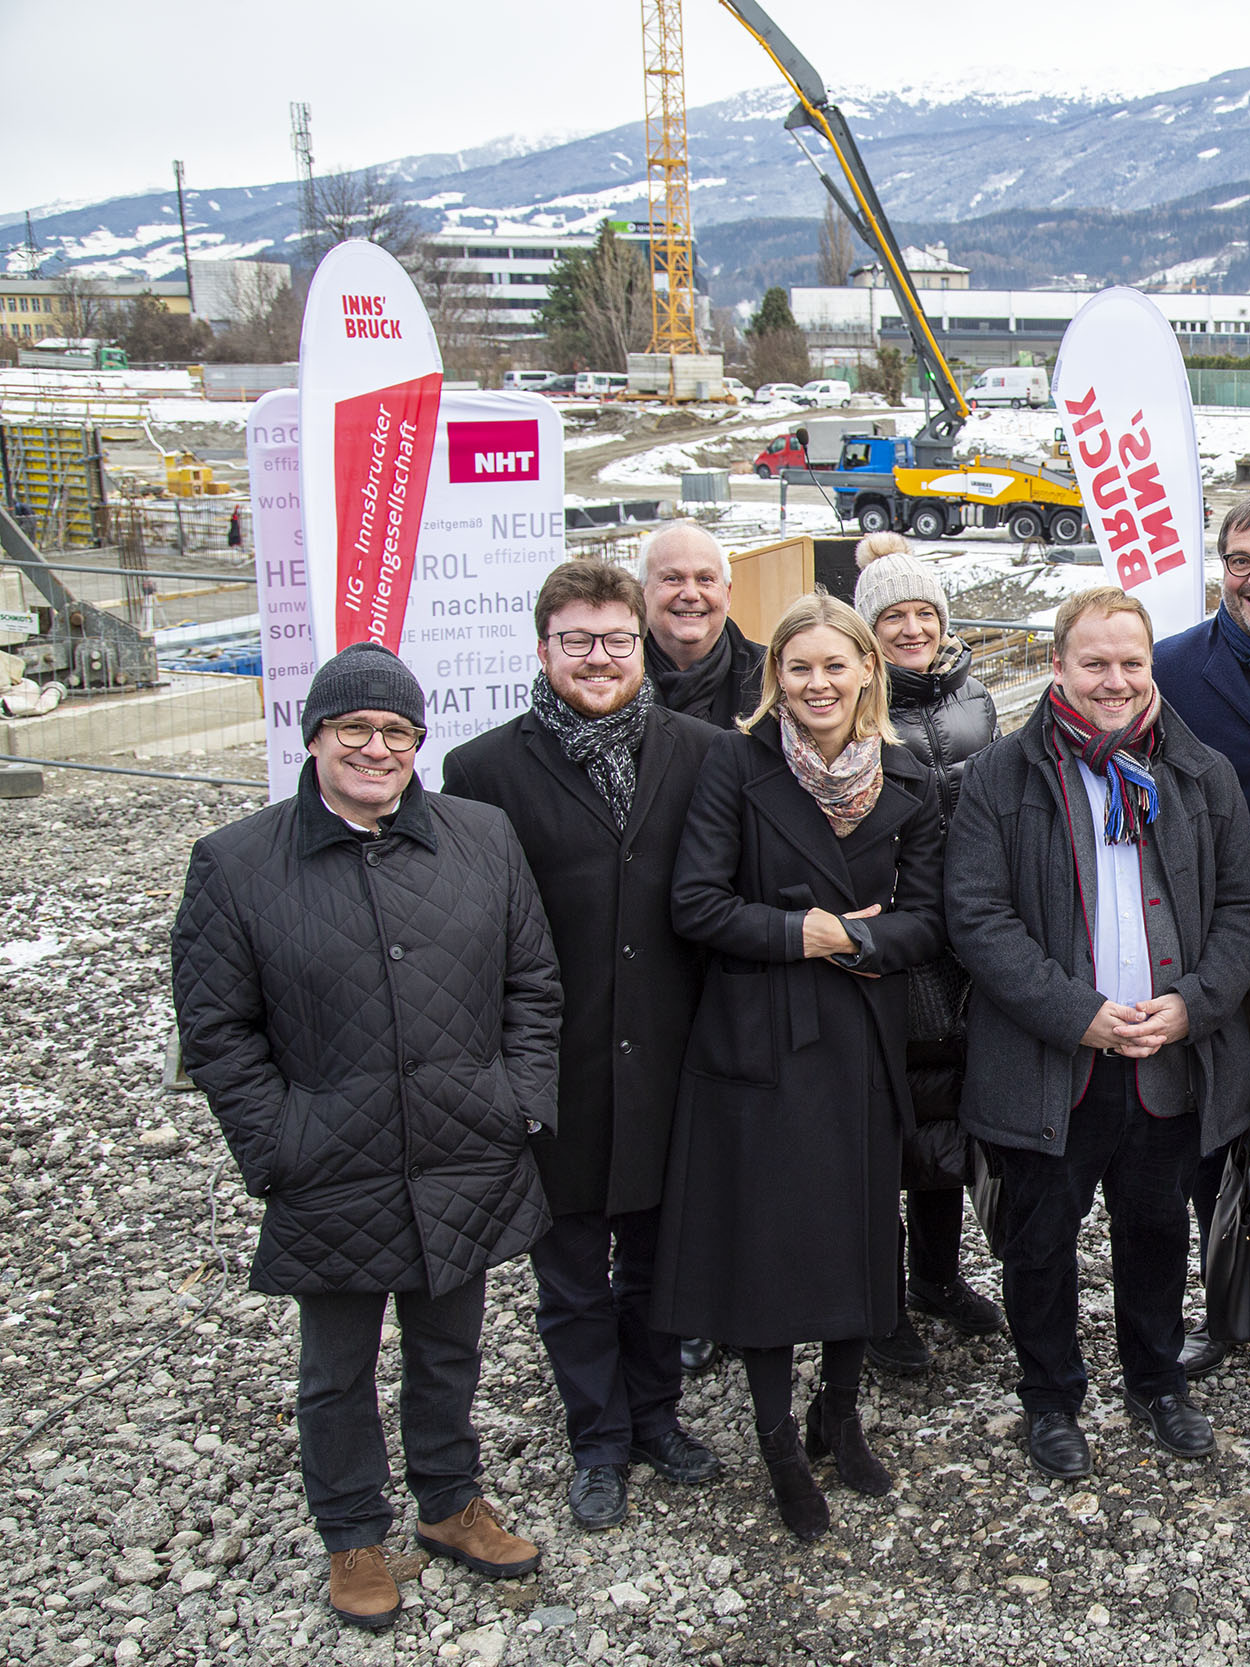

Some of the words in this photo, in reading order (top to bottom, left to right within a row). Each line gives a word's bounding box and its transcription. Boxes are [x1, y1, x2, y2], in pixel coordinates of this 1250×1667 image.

[342, 295, 386, 316] INNS'
[345, 318, 402, 339] BRUCK
[474, 451, 534, 473] NHT
[354, 403, 391, 553] Innsbrucker
[423, 518, 483, 532] zeitgemäß
[491, 512, 563, 539] NEUE
[483, 547, 556, 564] effizient
[345, 576, 364, 611] IIG
[421, 626, 473, 642] HEIMAT
[478, 624, 517, 639] TIROL
